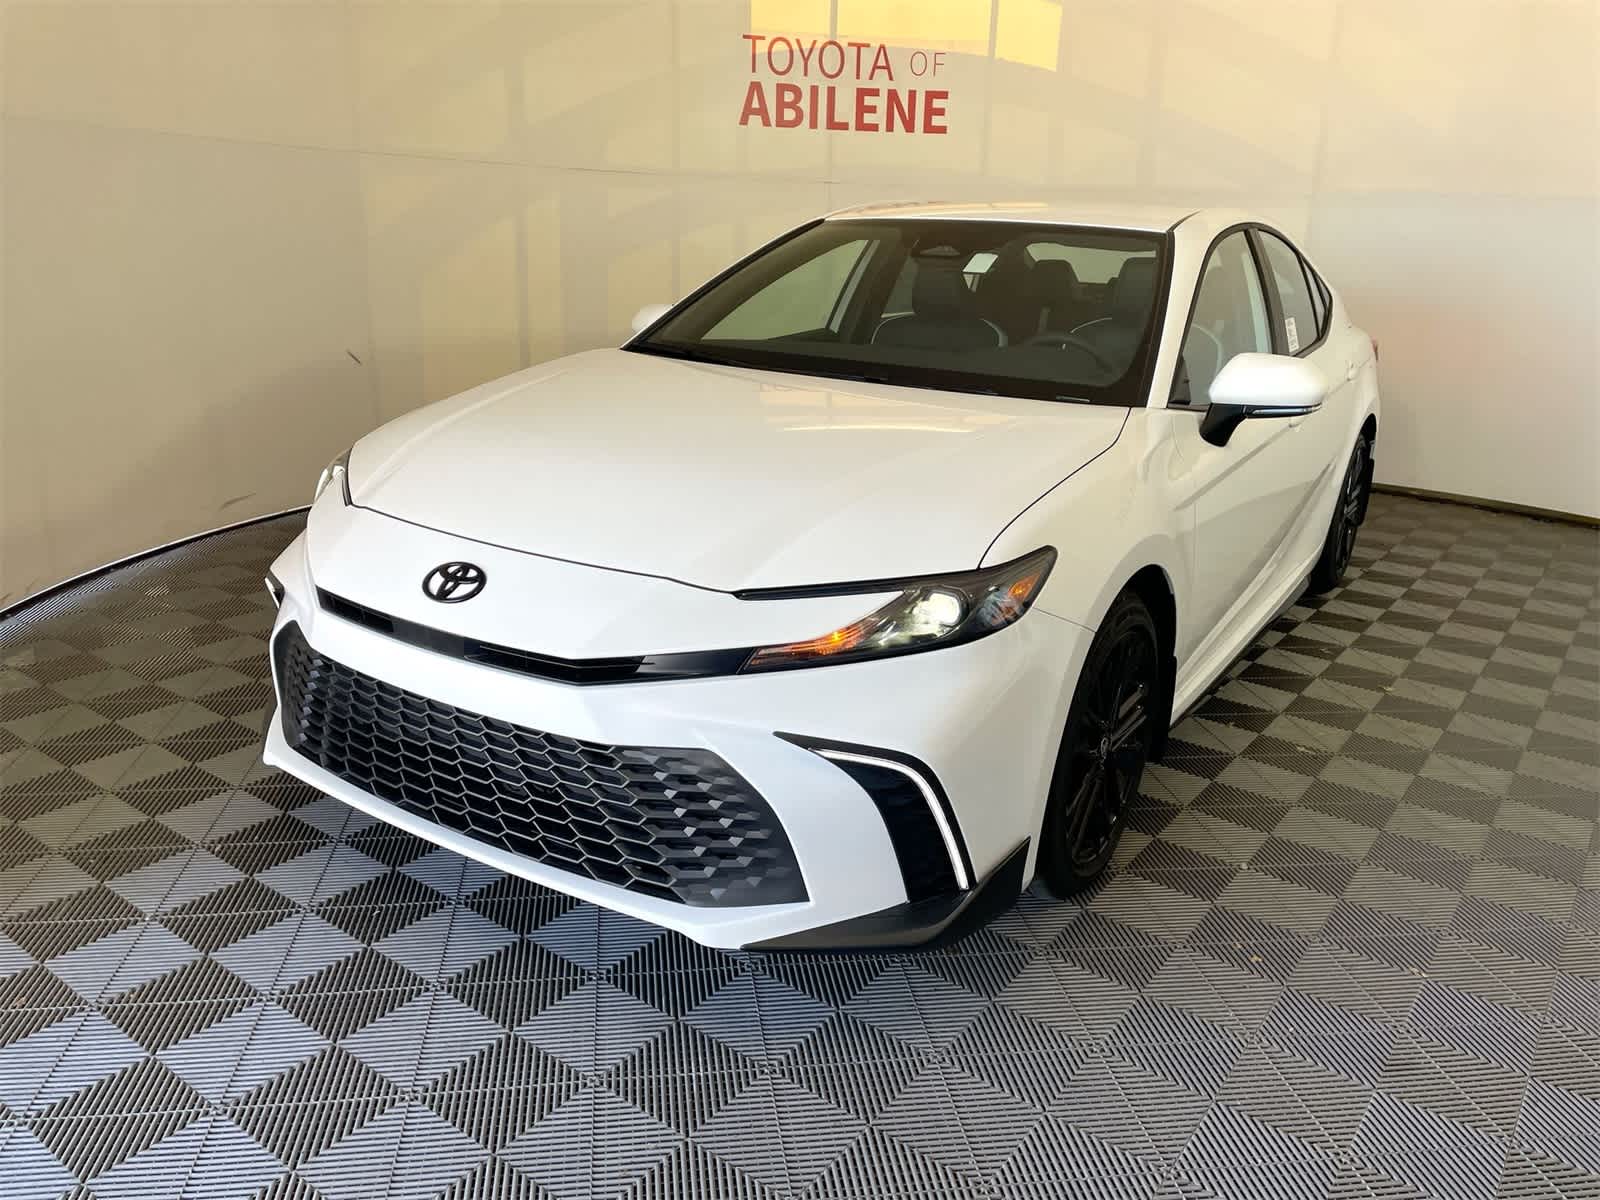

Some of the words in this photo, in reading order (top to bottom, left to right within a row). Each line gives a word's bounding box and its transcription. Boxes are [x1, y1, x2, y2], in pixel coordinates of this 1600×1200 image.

[742, 34, 894, 81] TOYOTA
[909, 51, 946, 77] OF
[738, 81, 949, 135] ABILENE
